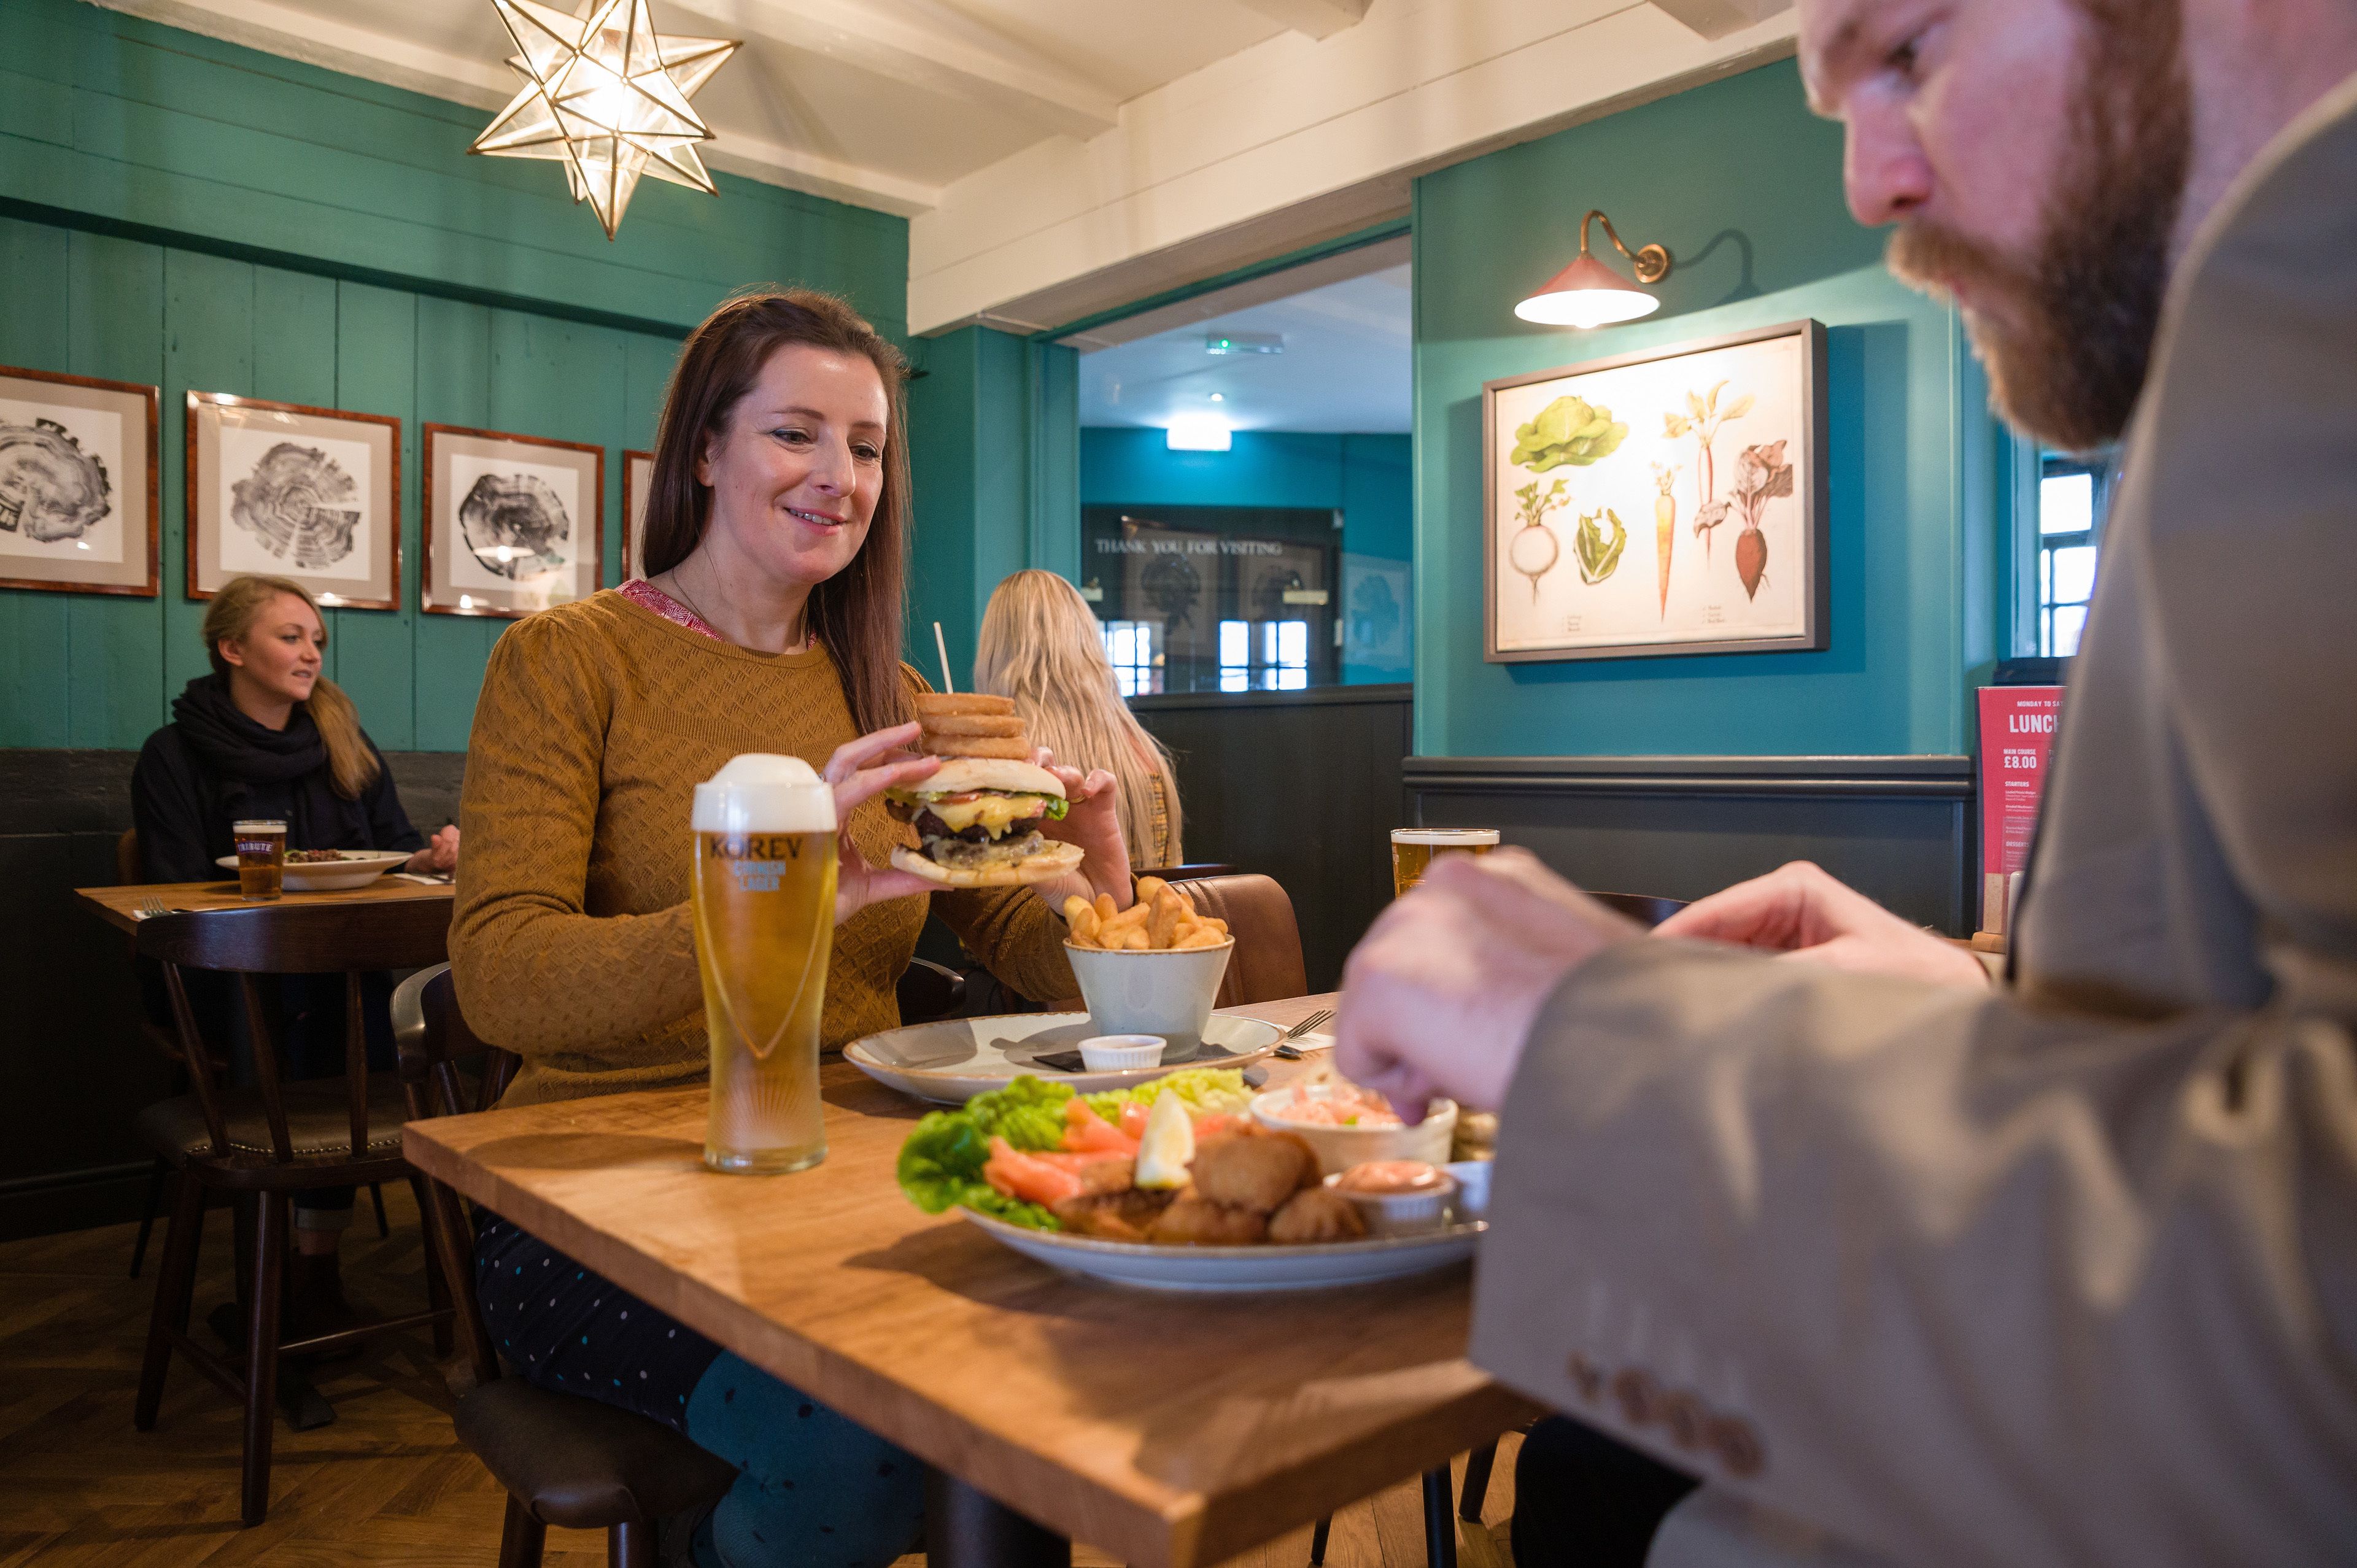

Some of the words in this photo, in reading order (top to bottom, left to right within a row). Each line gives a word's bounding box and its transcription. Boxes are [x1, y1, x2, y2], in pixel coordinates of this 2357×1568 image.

[1095, 538, 1146, 554] THANK
[1151, 539, 1182, 555] YOU
[1186, 539, 1218, 555] FOR
[1219, 540, 1282, 556] VISITING
[2004, 755, 2037, 768] £8.00
[710, 836, 803, 860] KOREV
